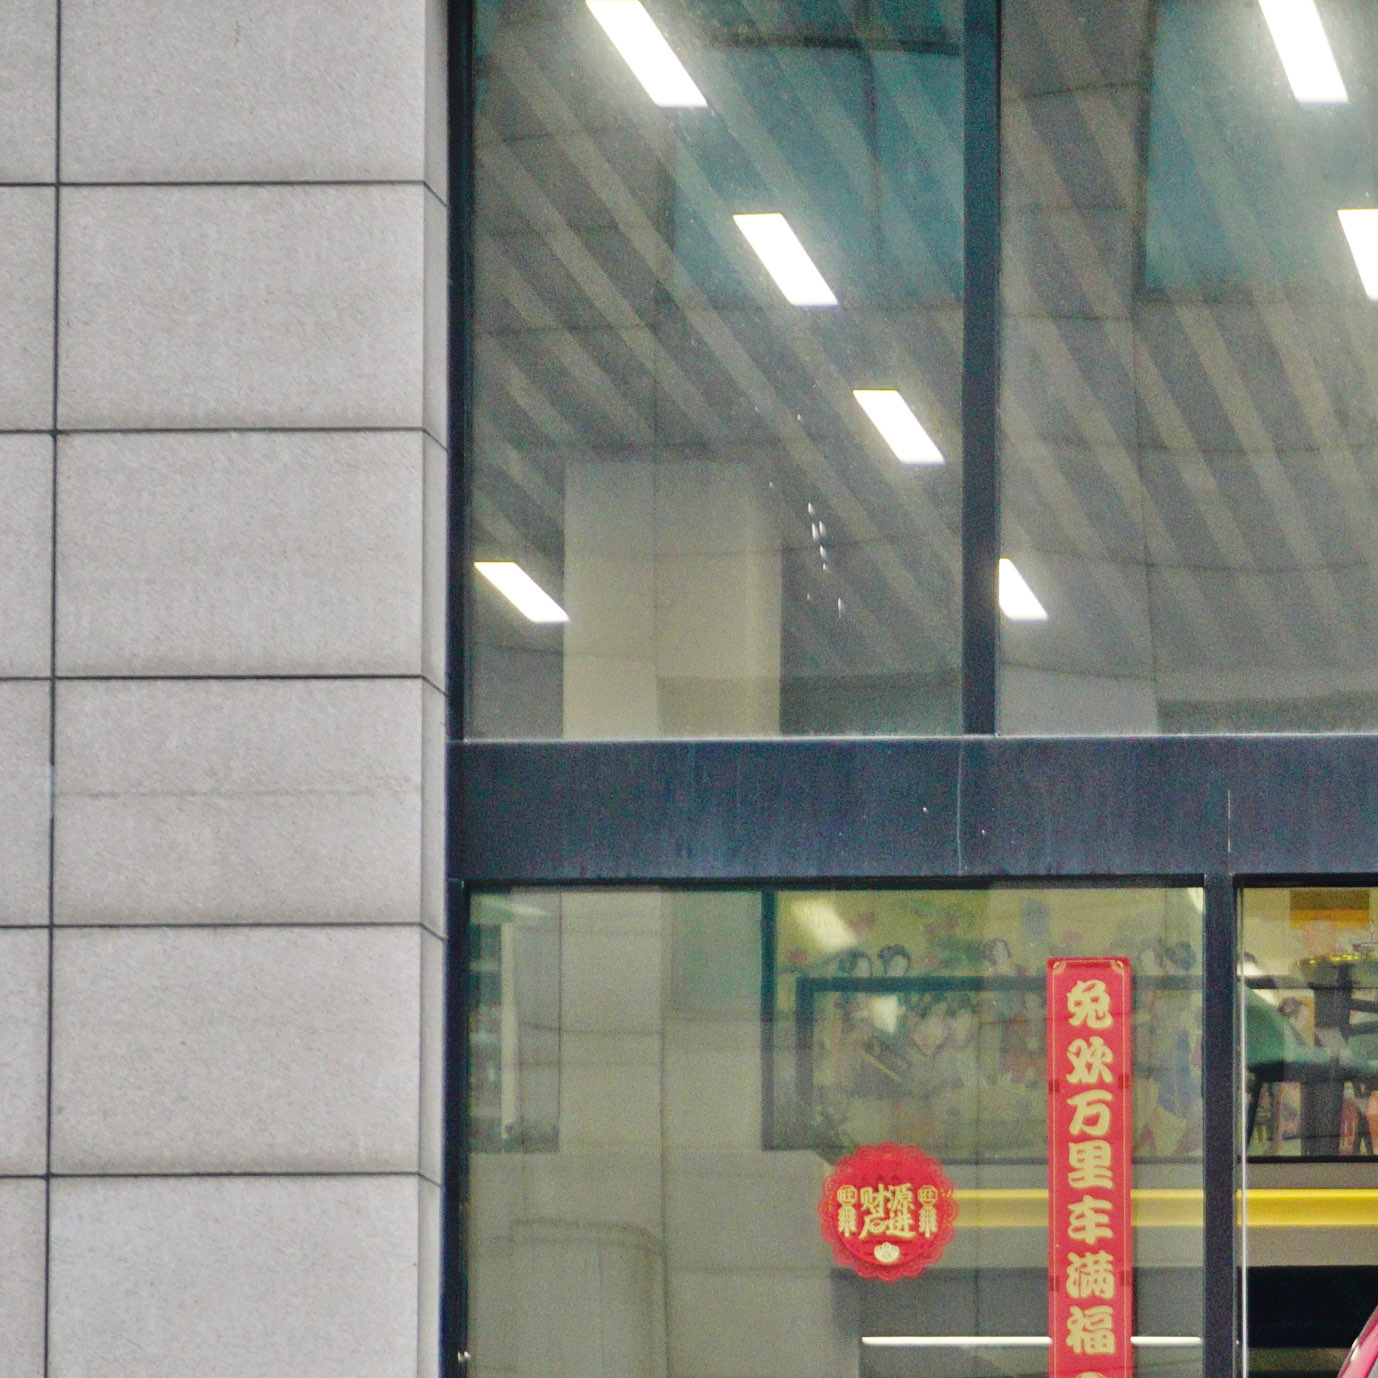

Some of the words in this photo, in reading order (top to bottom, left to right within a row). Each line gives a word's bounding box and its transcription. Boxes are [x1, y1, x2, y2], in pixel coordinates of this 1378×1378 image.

[1066, 979, 1116, 1356] 兔欢万里车满福
[859, 1183, 915, 1217] 财源
[858, 1212, 917, 1239] 广进
